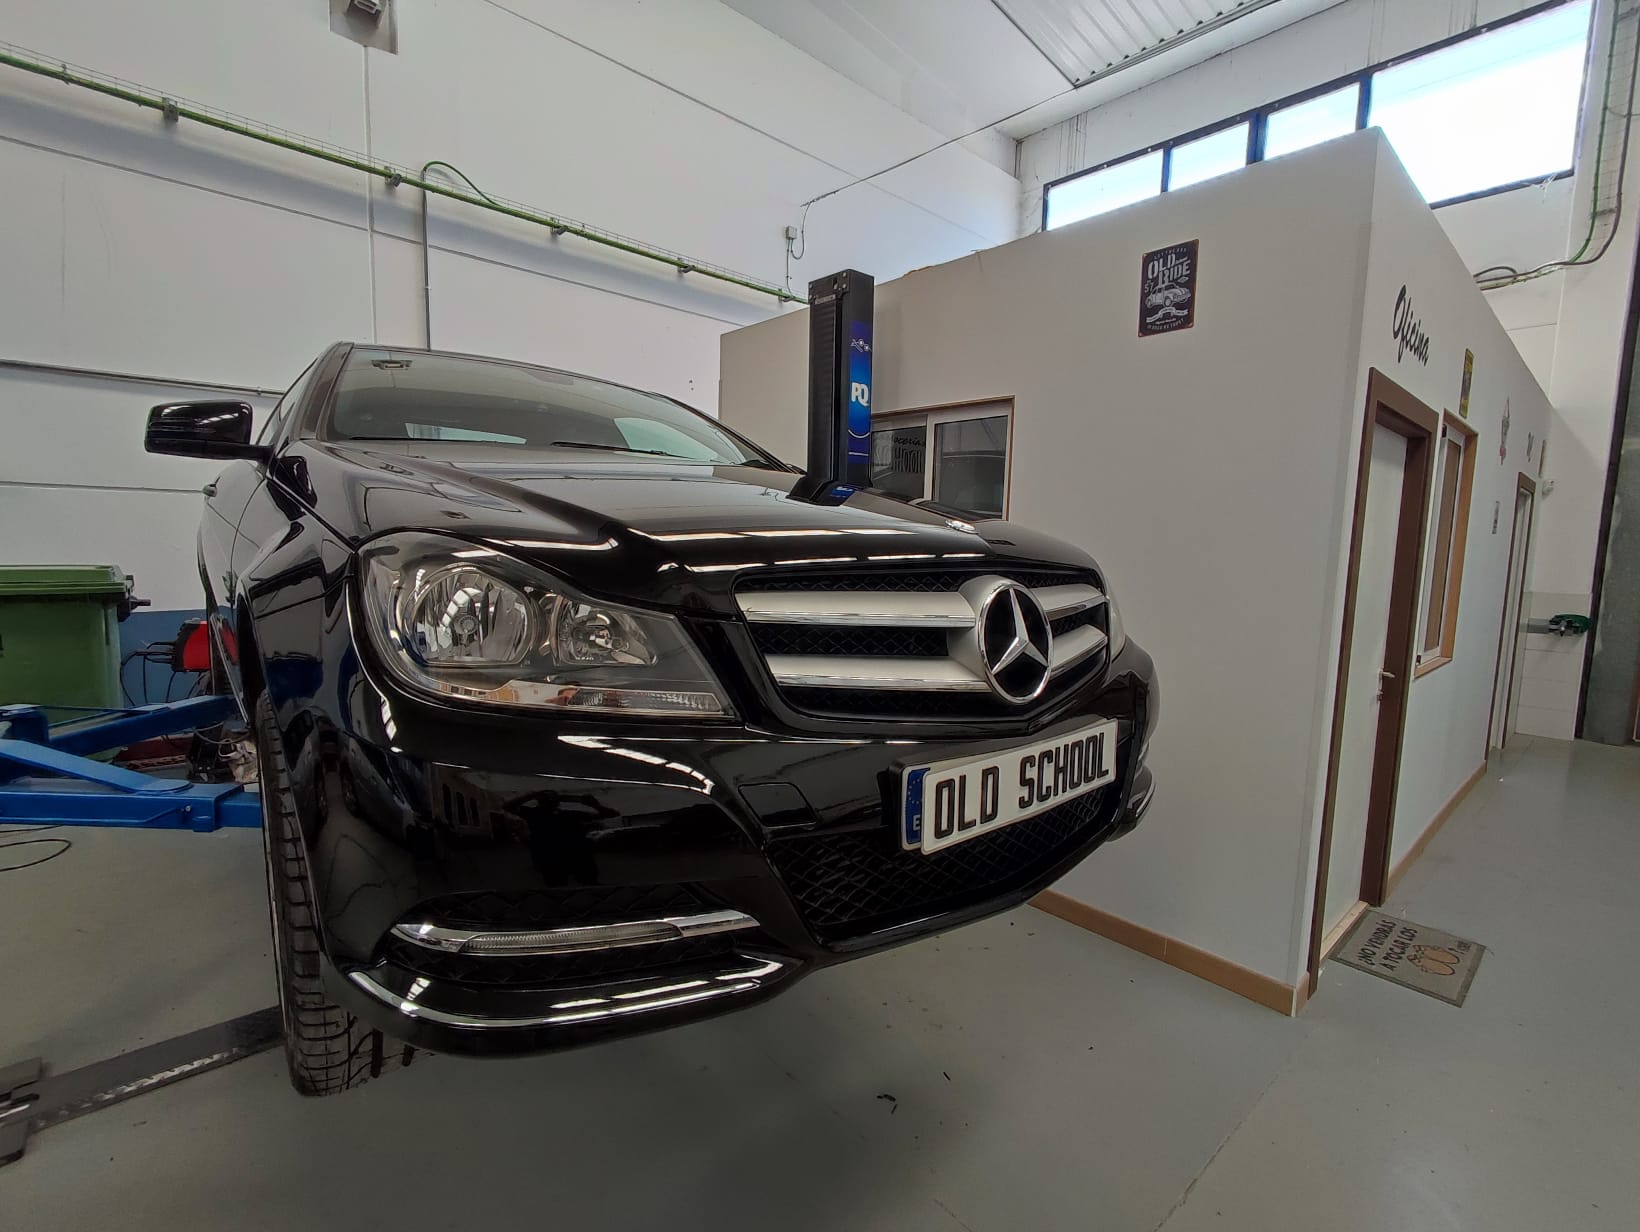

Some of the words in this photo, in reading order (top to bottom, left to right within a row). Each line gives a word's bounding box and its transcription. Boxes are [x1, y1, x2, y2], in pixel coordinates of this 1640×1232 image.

[1148, 253, 1176, 280] OLD
[1158, 260, 1191, 288] RIDE
[1393, 284, 1429, 366] Oficina
[934, 765, 999, 839] OLD
[1018, 732, 1109, 809] SCHOOL
[1382, 940, 1411, 963] TOCAR
[1397, 926, 1418, 941] LOS
